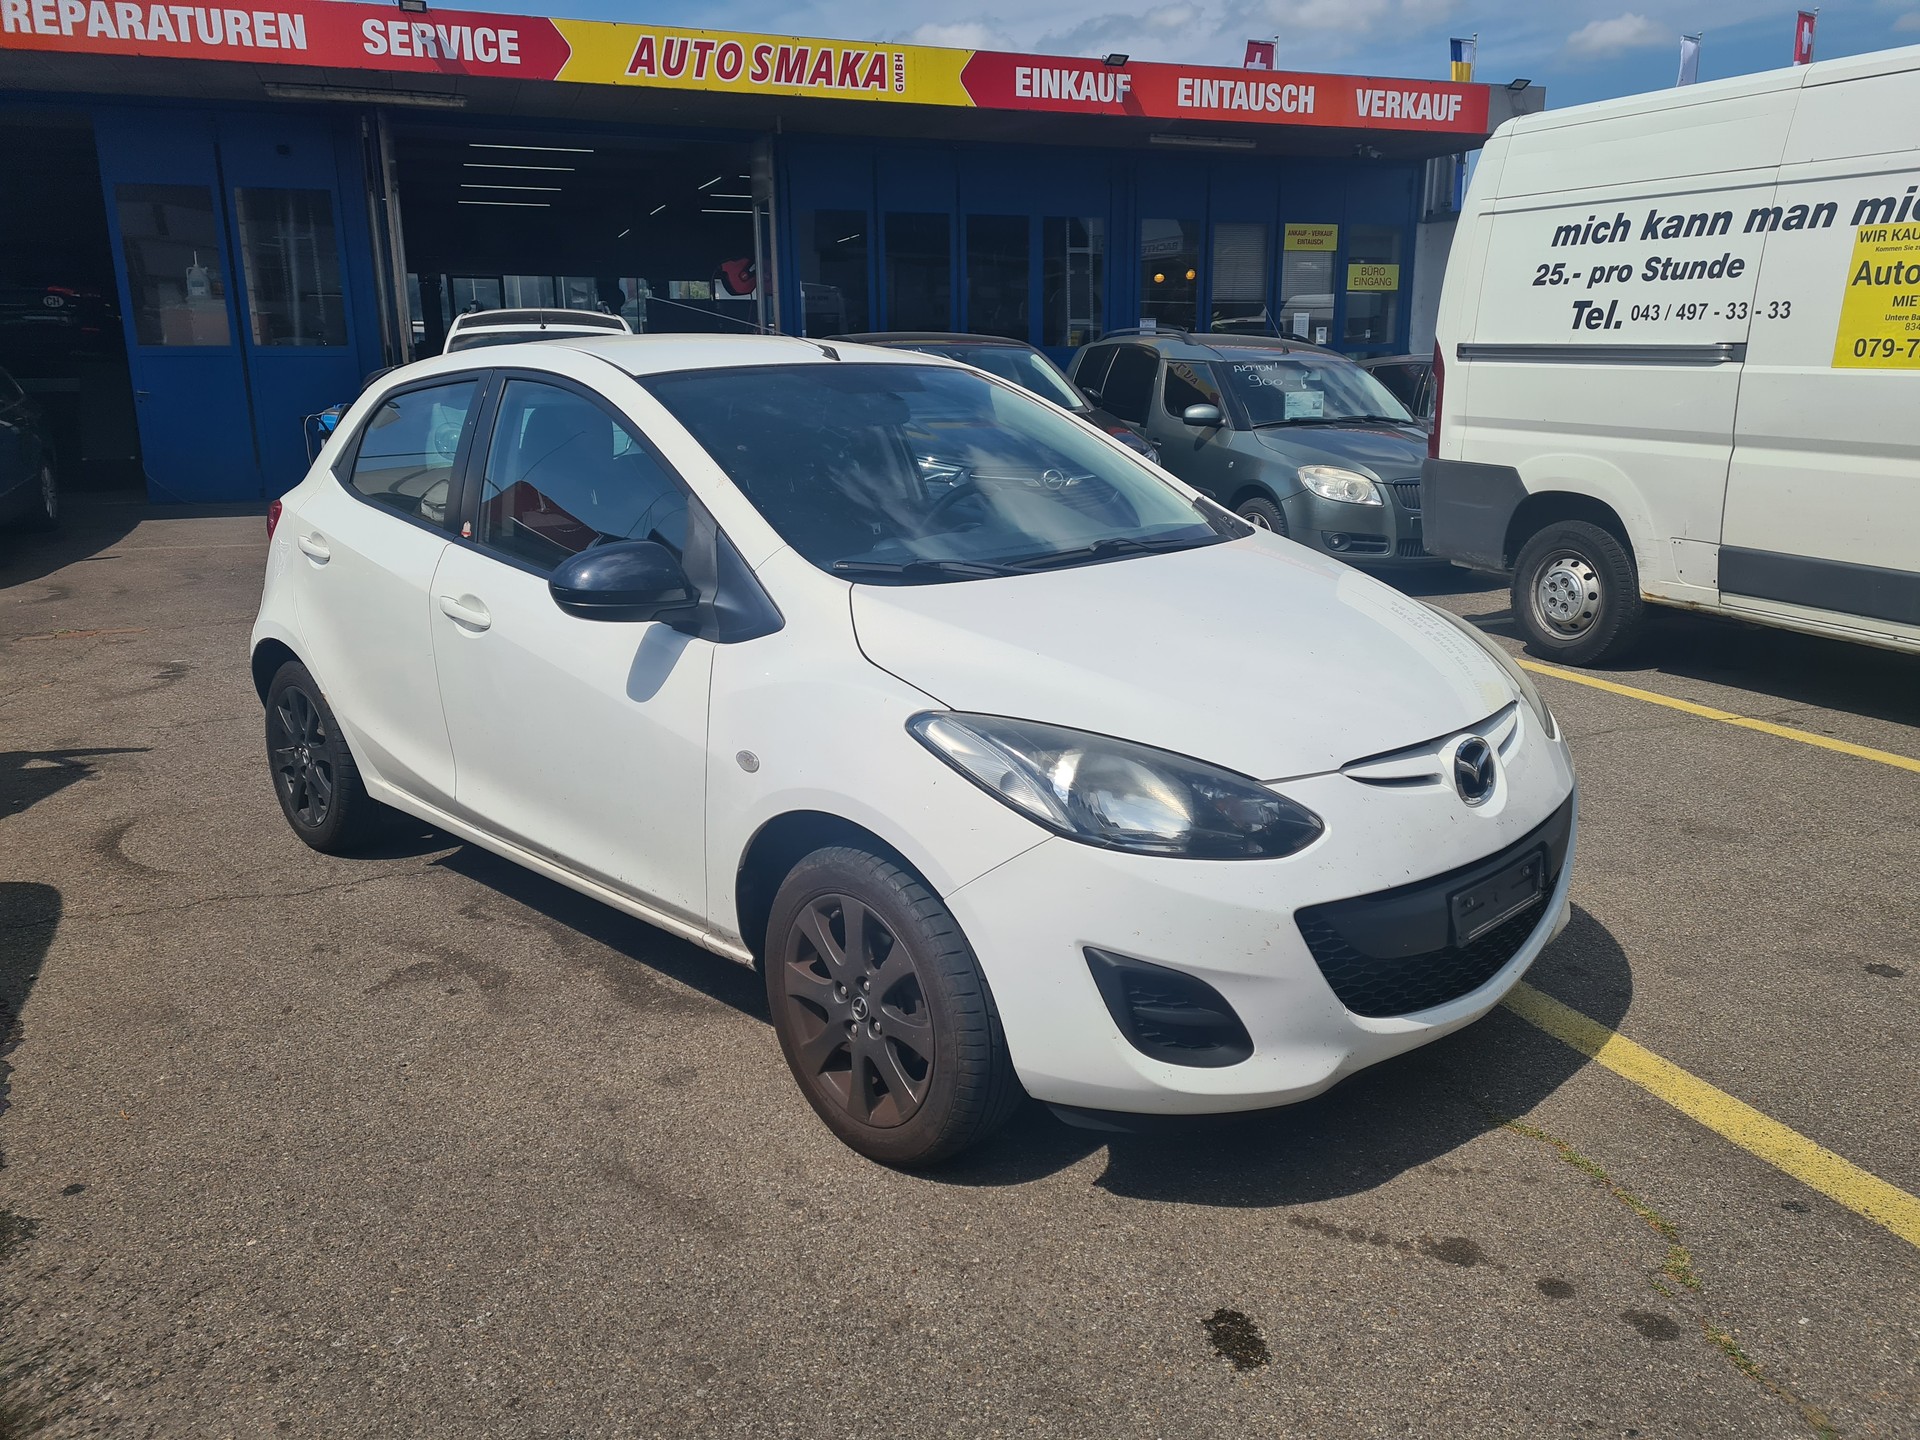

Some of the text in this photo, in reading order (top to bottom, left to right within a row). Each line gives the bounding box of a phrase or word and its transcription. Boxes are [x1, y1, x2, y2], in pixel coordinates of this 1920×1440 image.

[1, 0, 308, 50] REPARATUREN
[361, 18, 521, 65] SERVICE
[894, 53, 905, 93] GMBH
[1015, 66, 1131, 103] EINKAUF
[1177, 77, 1315, 114] EINTAUSCH
[1356, 88, 1462, 122] VERKAUF
[1287, 229, 1307, 237] ANKAUF
[1551, 212, 1632, 247] mich
[1640, 209, 1733, 240] kann
[1743, 201, 1838, 234] man
[1860, 230, 1888, 243] WIR
[1296, 238, 1324, 246] EINTAUSCH
[1353, 277, 1392, 286] EINGANG
[1361, 266, 1386, 276] BÜRO
[1532, 252, 1745, 289] 25.- pro Stunde
[1852, 260, 1920, 286] Auto
[1572, 299, 1623, 330] Tel.
[1892, 295, 1920, 307] MIE
[1854, 338, 1920, 358] 079-7
